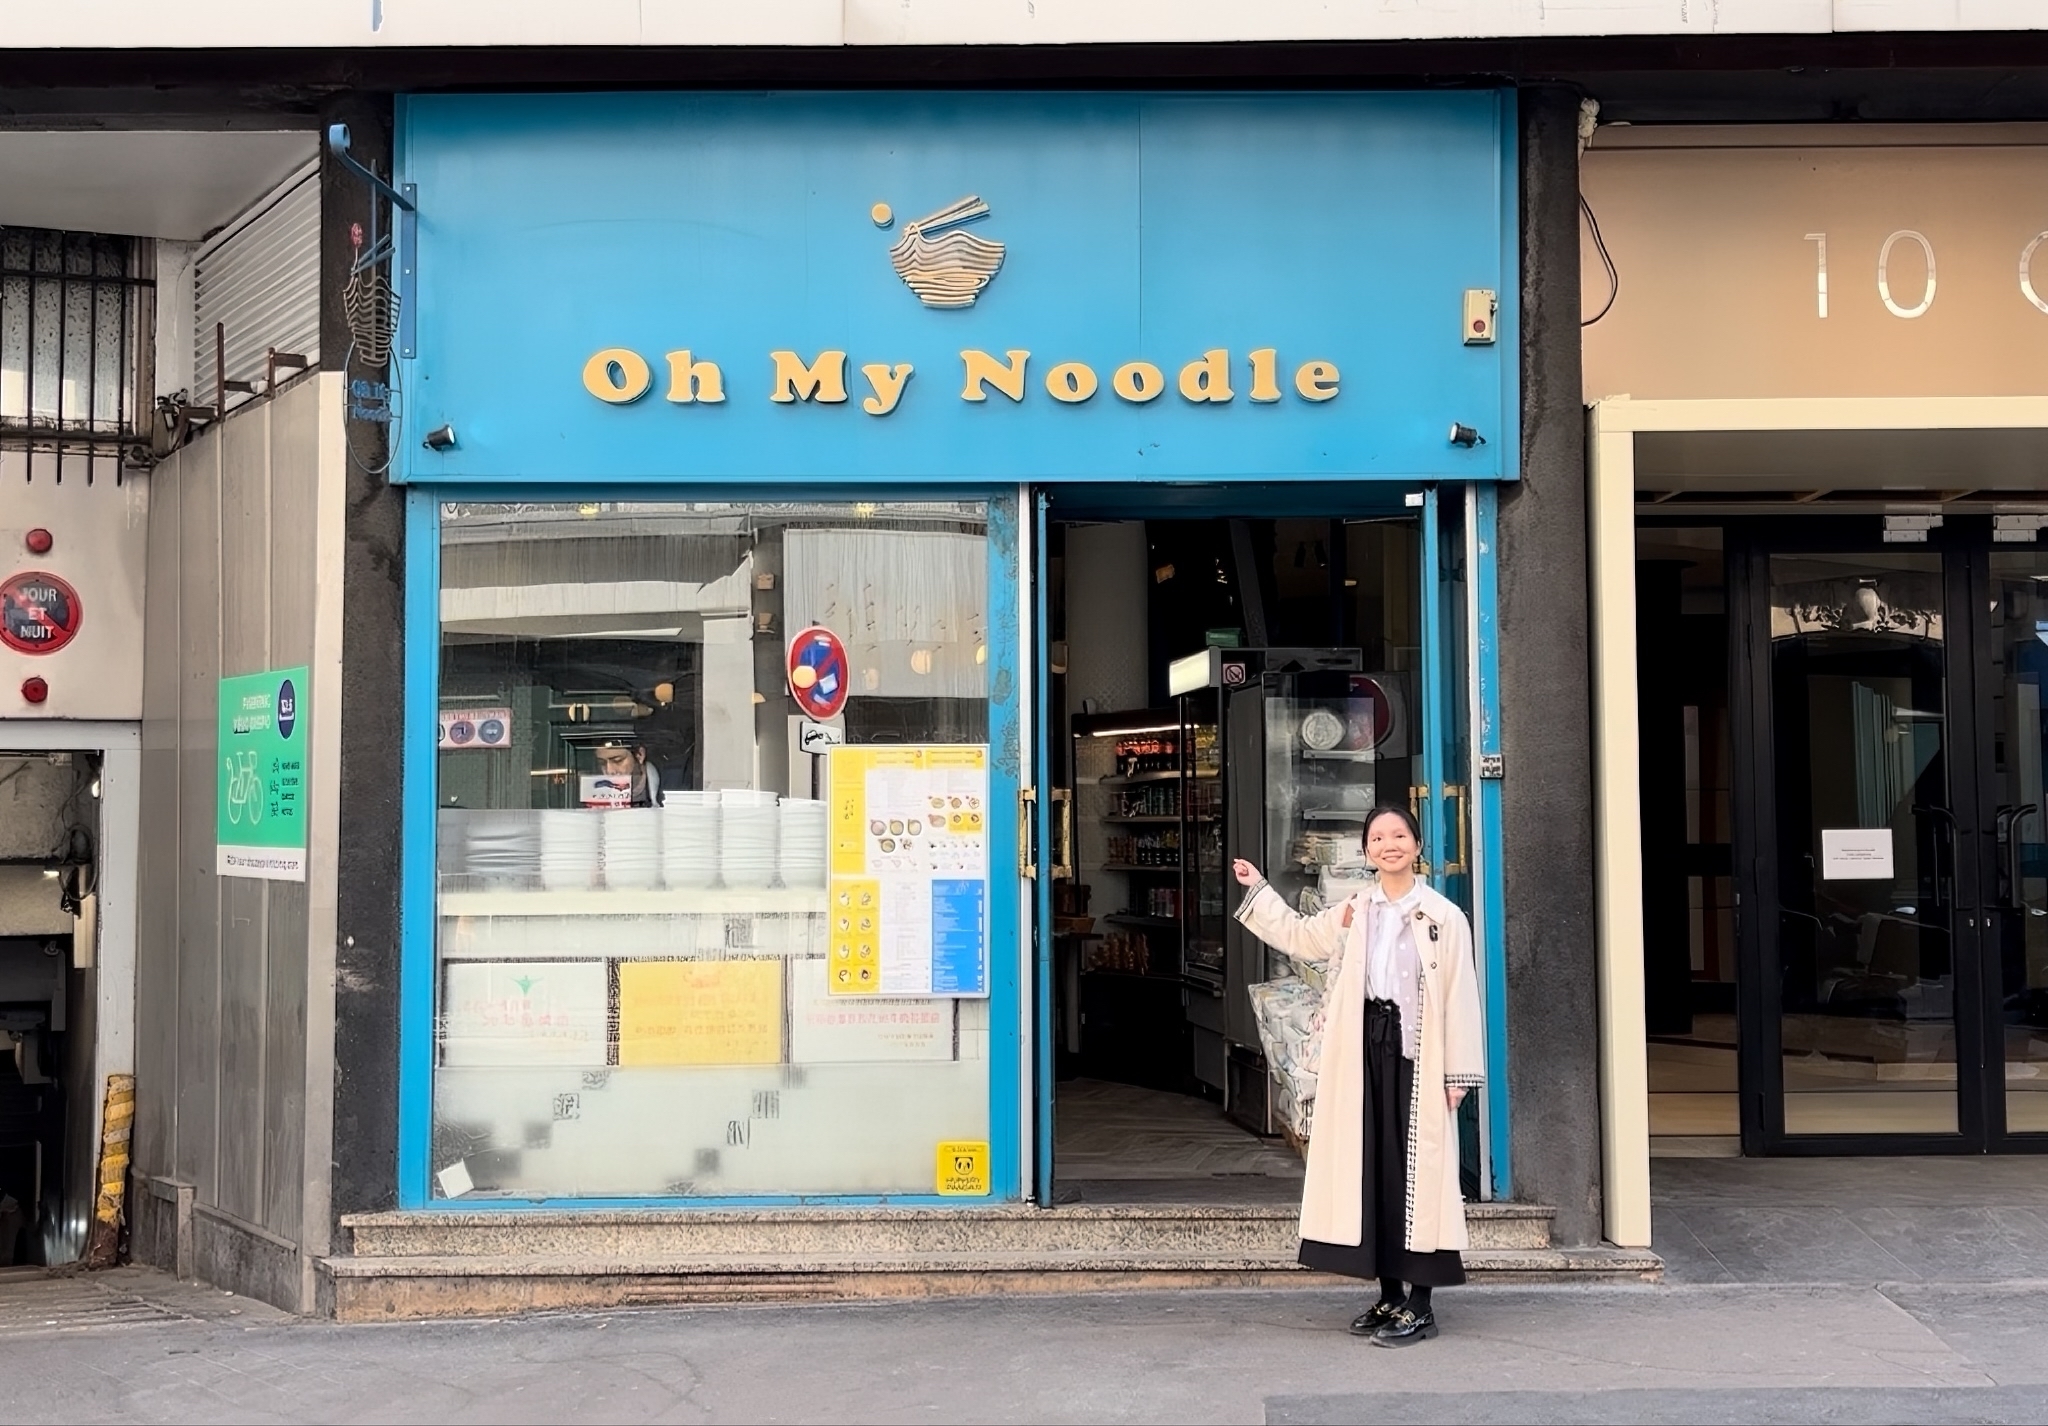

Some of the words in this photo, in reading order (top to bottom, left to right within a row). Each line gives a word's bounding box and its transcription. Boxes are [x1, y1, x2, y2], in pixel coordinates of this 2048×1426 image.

[1804, 229, 1937, 319] 10
[583, 348, 727, 404] Oh
[769, 350, 914, 416] My
[960, 349, 1342, 404] Noodle
[19, 587, 58, 603] JOUR
[28, 607, 48, 621] ET
[20, 625, 55, 639] NUIT
